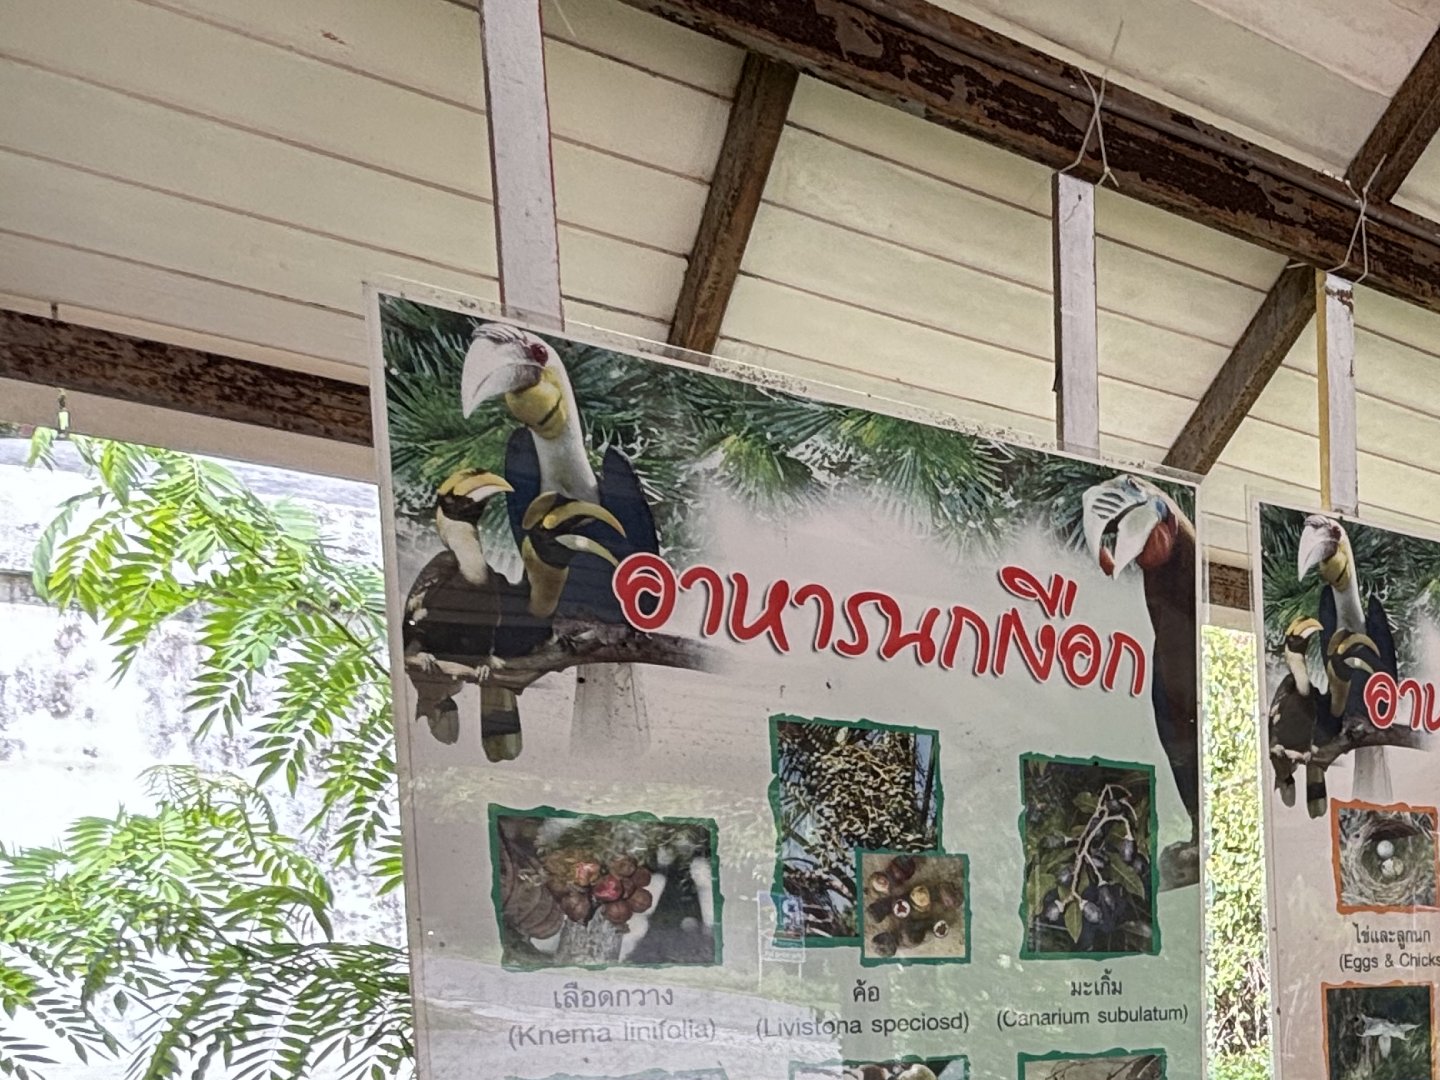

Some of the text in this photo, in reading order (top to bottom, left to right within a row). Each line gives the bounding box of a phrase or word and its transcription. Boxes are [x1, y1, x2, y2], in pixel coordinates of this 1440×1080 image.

[613, 551, 1147, 697] อาหารนกเงือก
[1353, 922, 1430, 949] ไข่และลูกนก
[1339, 953, 1379, 973] (Eggs
[1384, 953, 1394, 967] &
[853, 979, 880, 1002] ค้อ
[1070, 968, 1123, 996] มะเกิ้ม
[553, 982, 673, 1010] เลือดกวาง
[756, 1017, 862, 1041] (Livistona
[997, 1004, 1188, 1031] (Canarium subulatum)
[508, 1018, 716, 1051] (Knema linifolia)
